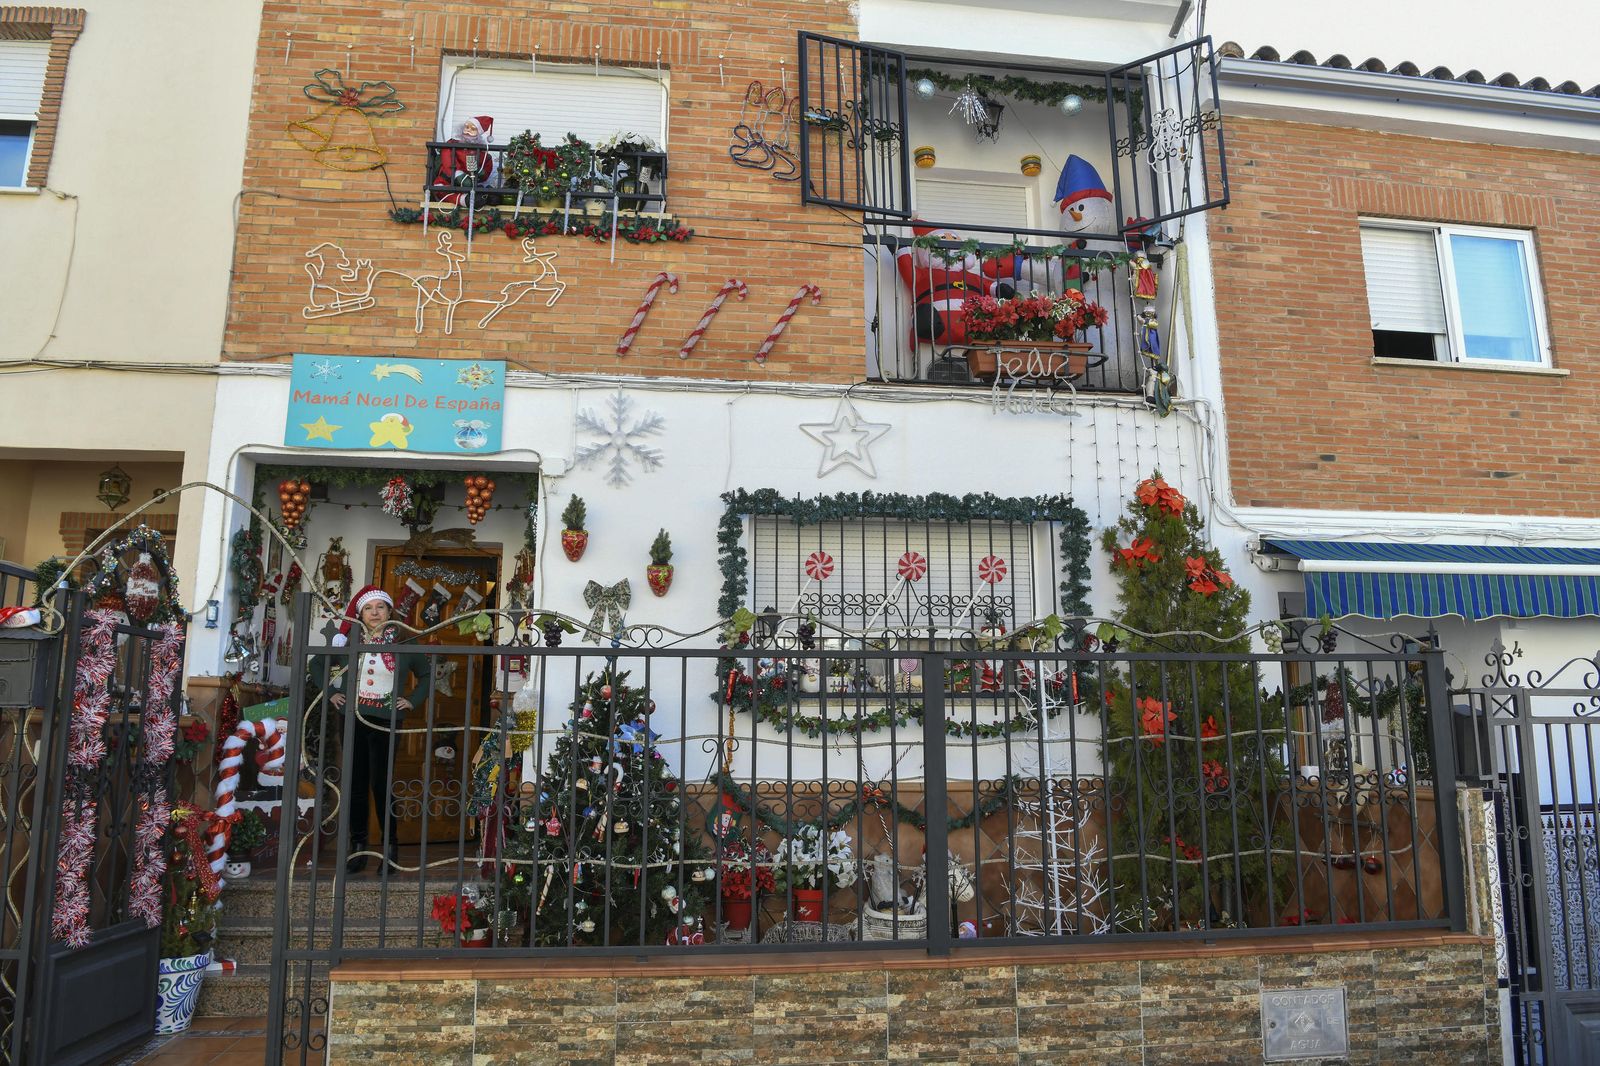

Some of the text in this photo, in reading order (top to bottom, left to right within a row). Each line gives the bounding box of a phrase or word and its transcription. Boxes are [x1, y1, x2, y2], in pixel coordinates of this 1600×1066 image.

[293, 390, 501, 413] Mamá Noel De España
[1512, 641, 1523, 657] 4
[1272, 994, 1335, 1006] CONTADOR
[1290, 1039, 1321, 1051] AGUA
